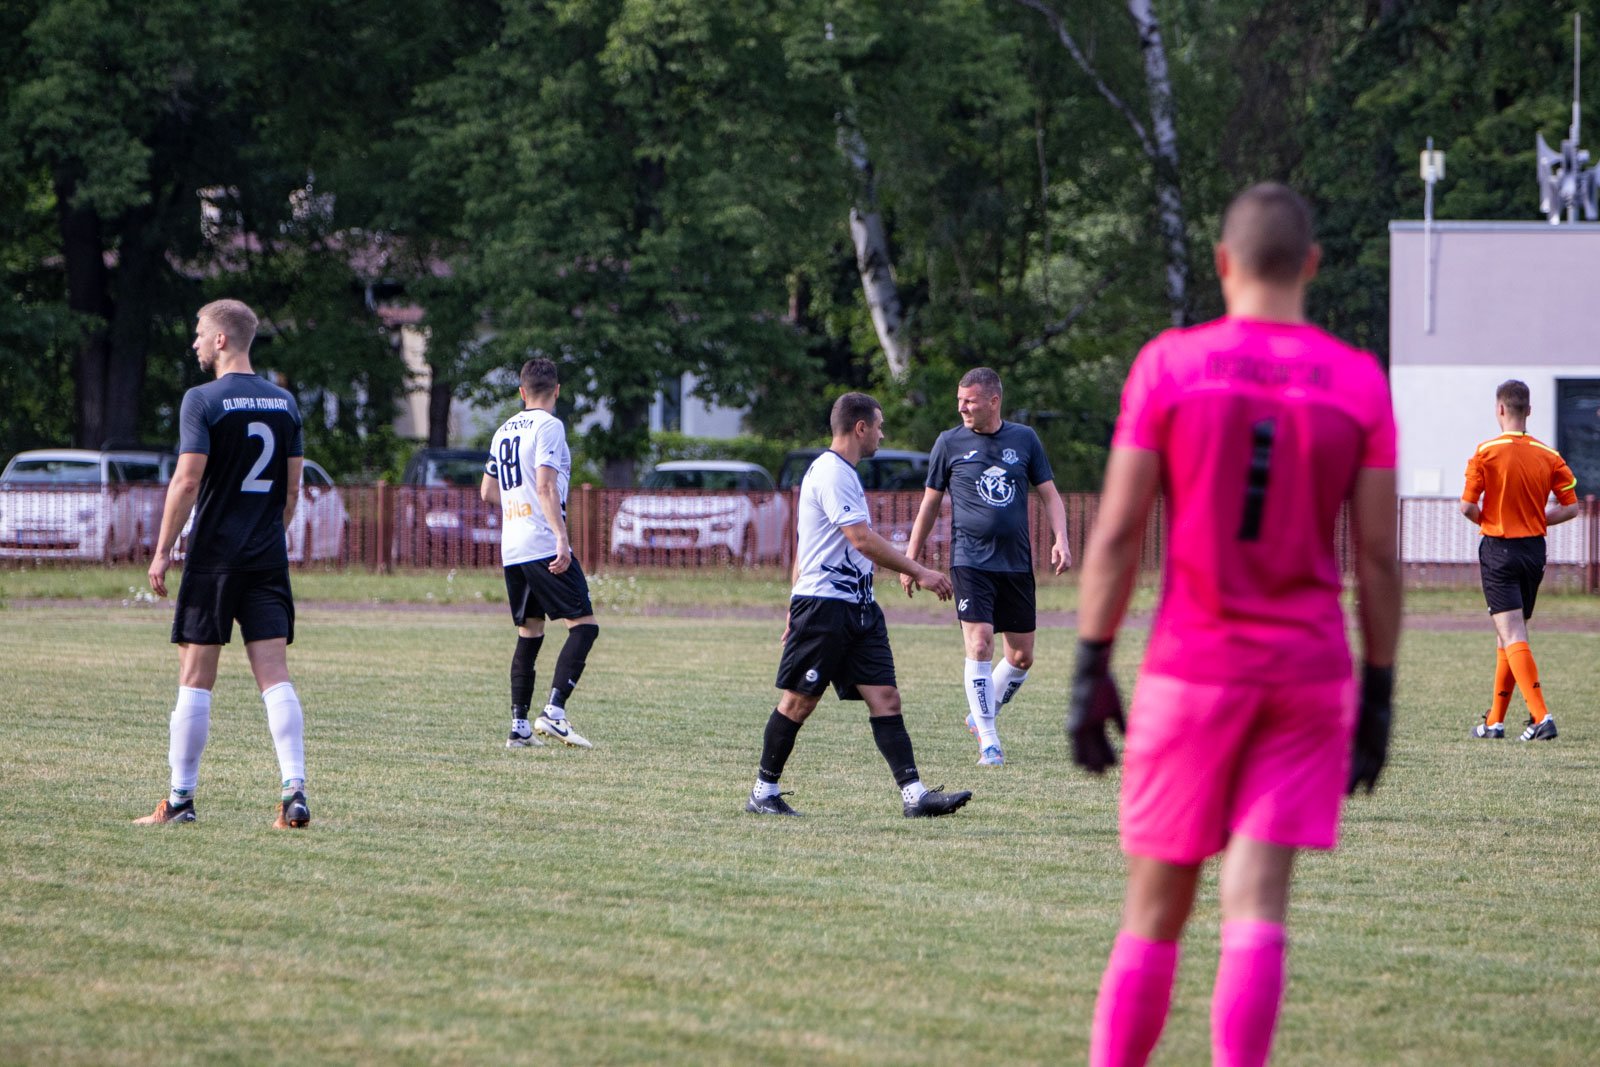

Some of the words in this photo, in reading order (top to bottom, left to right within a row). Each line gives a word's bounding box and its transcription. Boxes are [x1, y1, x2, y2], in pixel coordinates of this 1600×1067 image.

[223, 398, 255, 411] OLIMPIA
[256, 398, 288, 411] KOWARY
[240, 422, 275, 492] 2
[499, 435, 523, 491] 89
[1236, 417, 1276, 541] 1
[958, 598, 969, 612] 16
